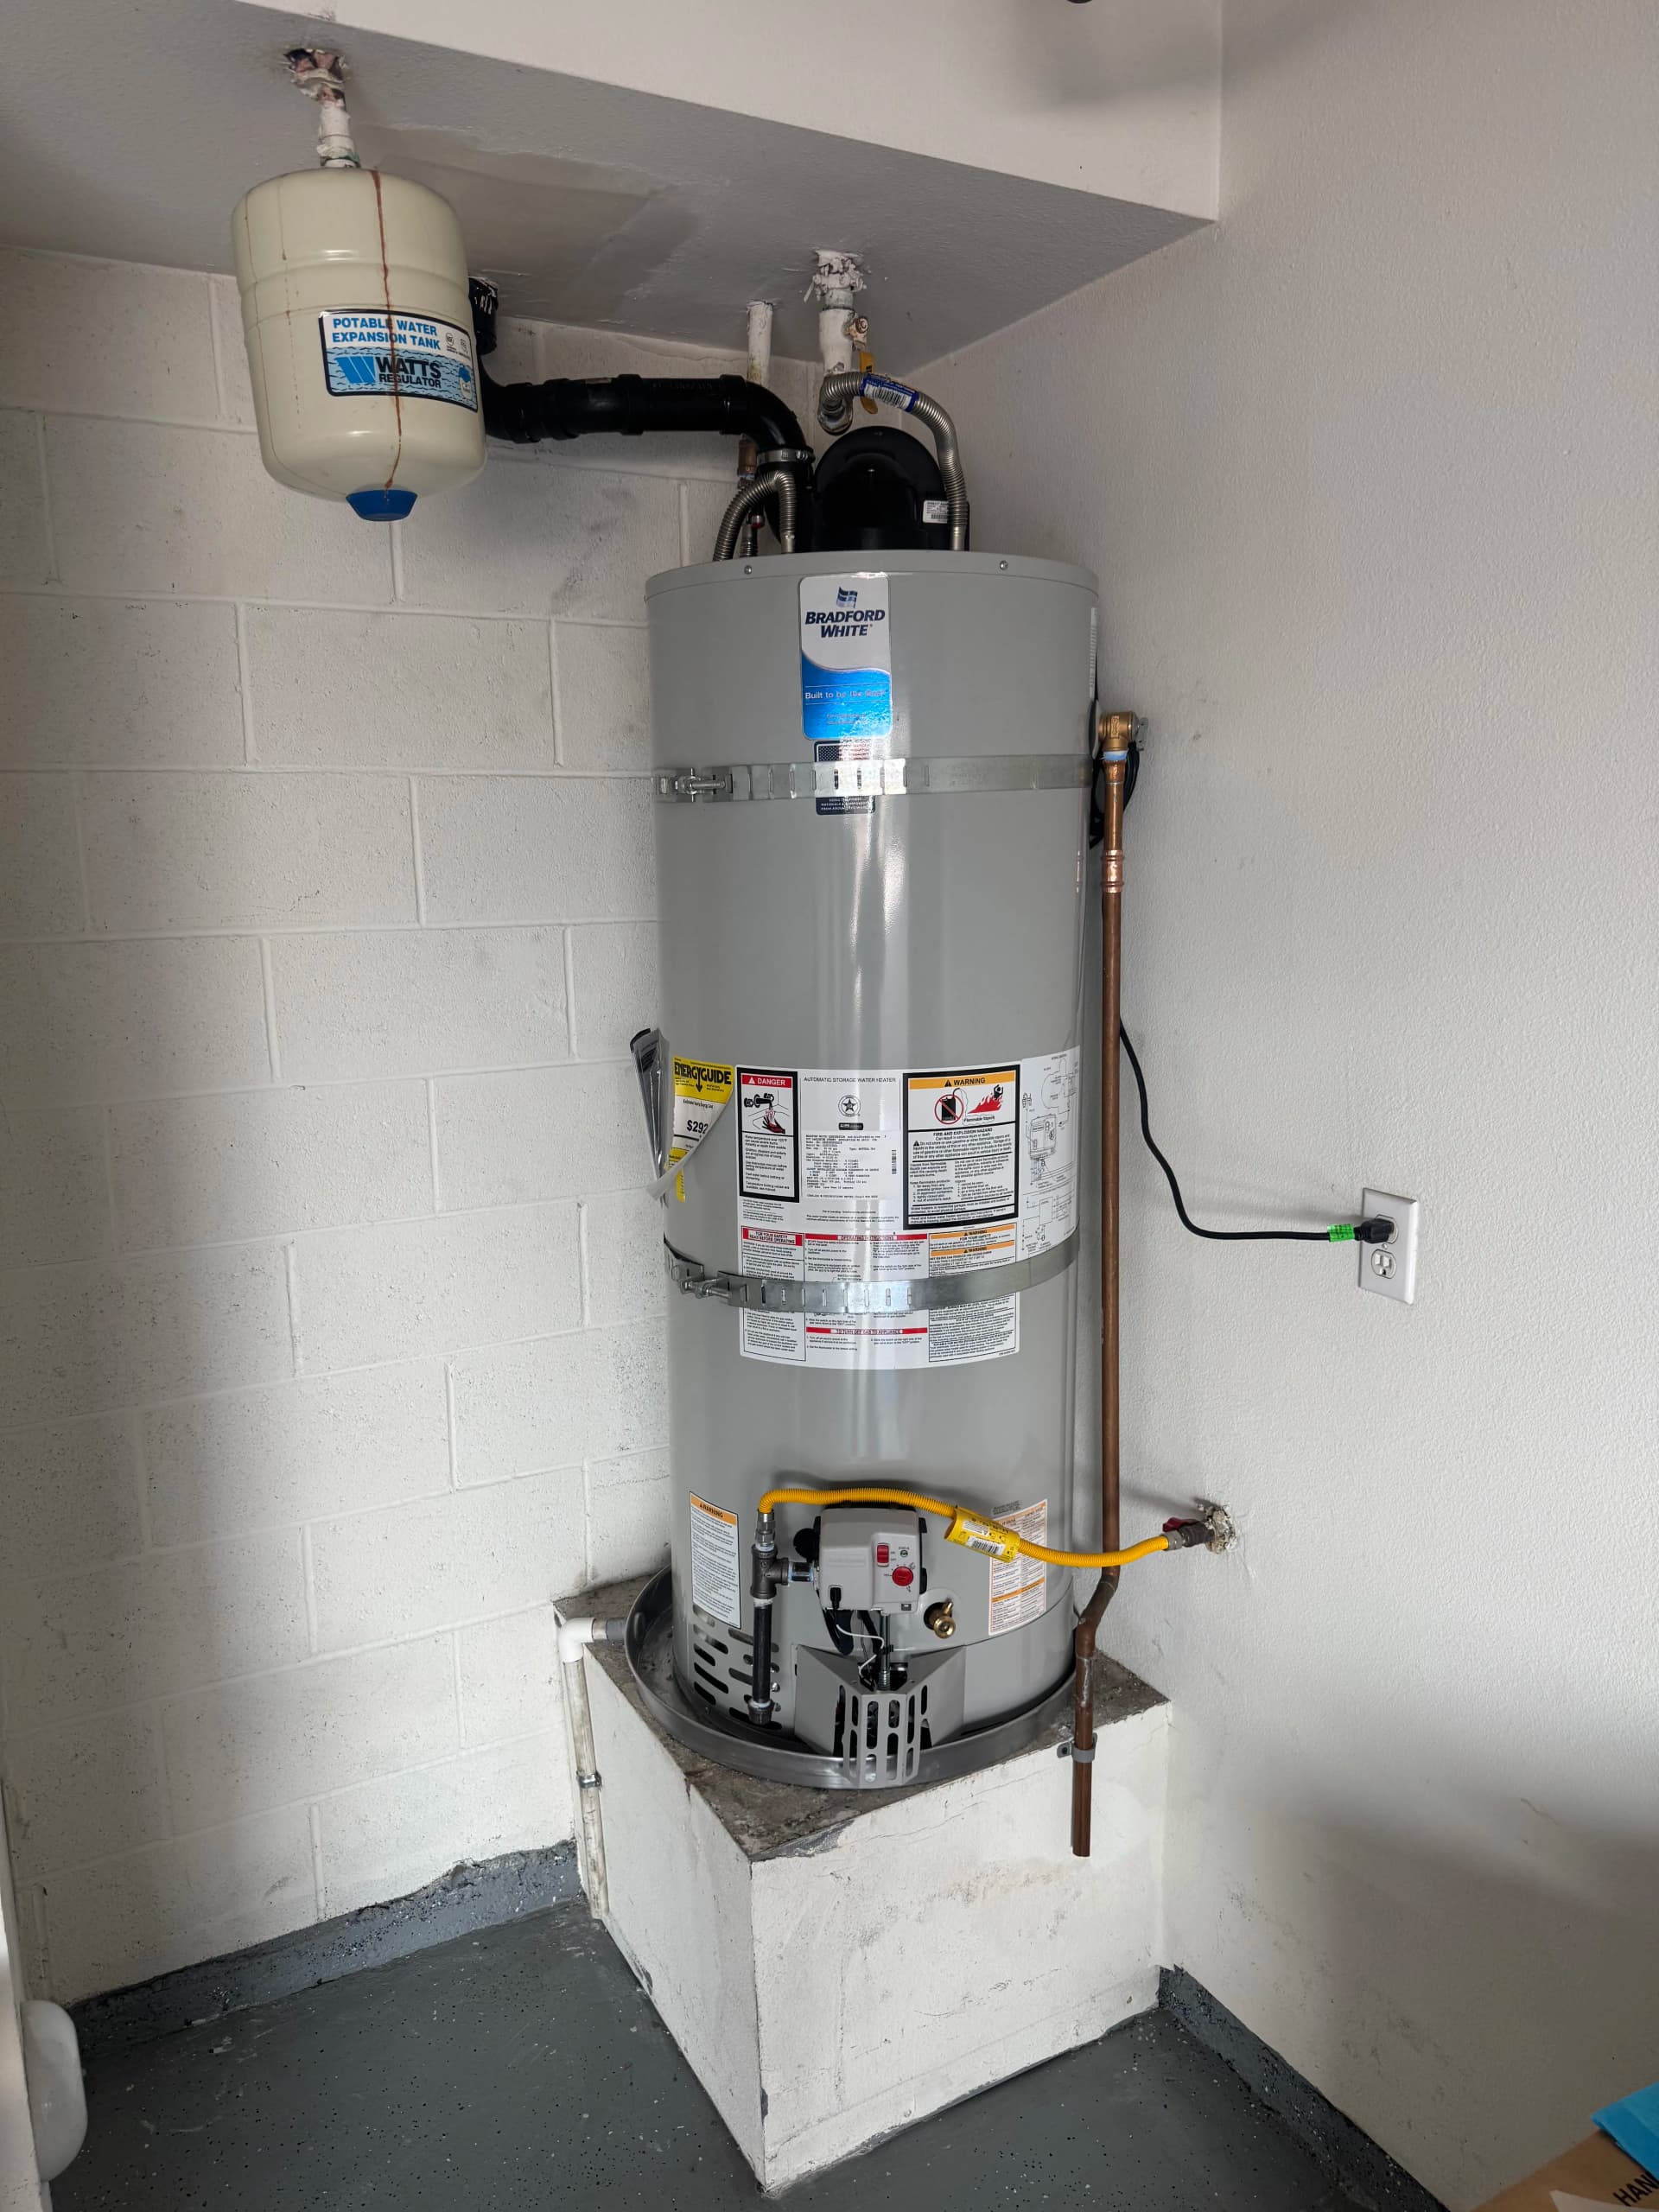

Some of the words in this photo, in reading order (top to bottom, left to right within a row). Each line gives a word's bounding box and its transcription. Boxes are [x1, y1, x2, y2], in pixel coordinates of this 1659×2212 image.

[333, 318, 392, 330] POTABLE
[397, 321, 437, 335] WATER
[332, 333, 407, 345] EXPANSION
[410, 335, 441, 350] TANK
[375, 356, 442, 379] WATTS
[378, 374, 442, 389] REGULATOR
[805, 609, 885, 625] BRADFORD
[821, 625, 868, 638] WHITE
[953, 1077, 986, 1086] WARNING
